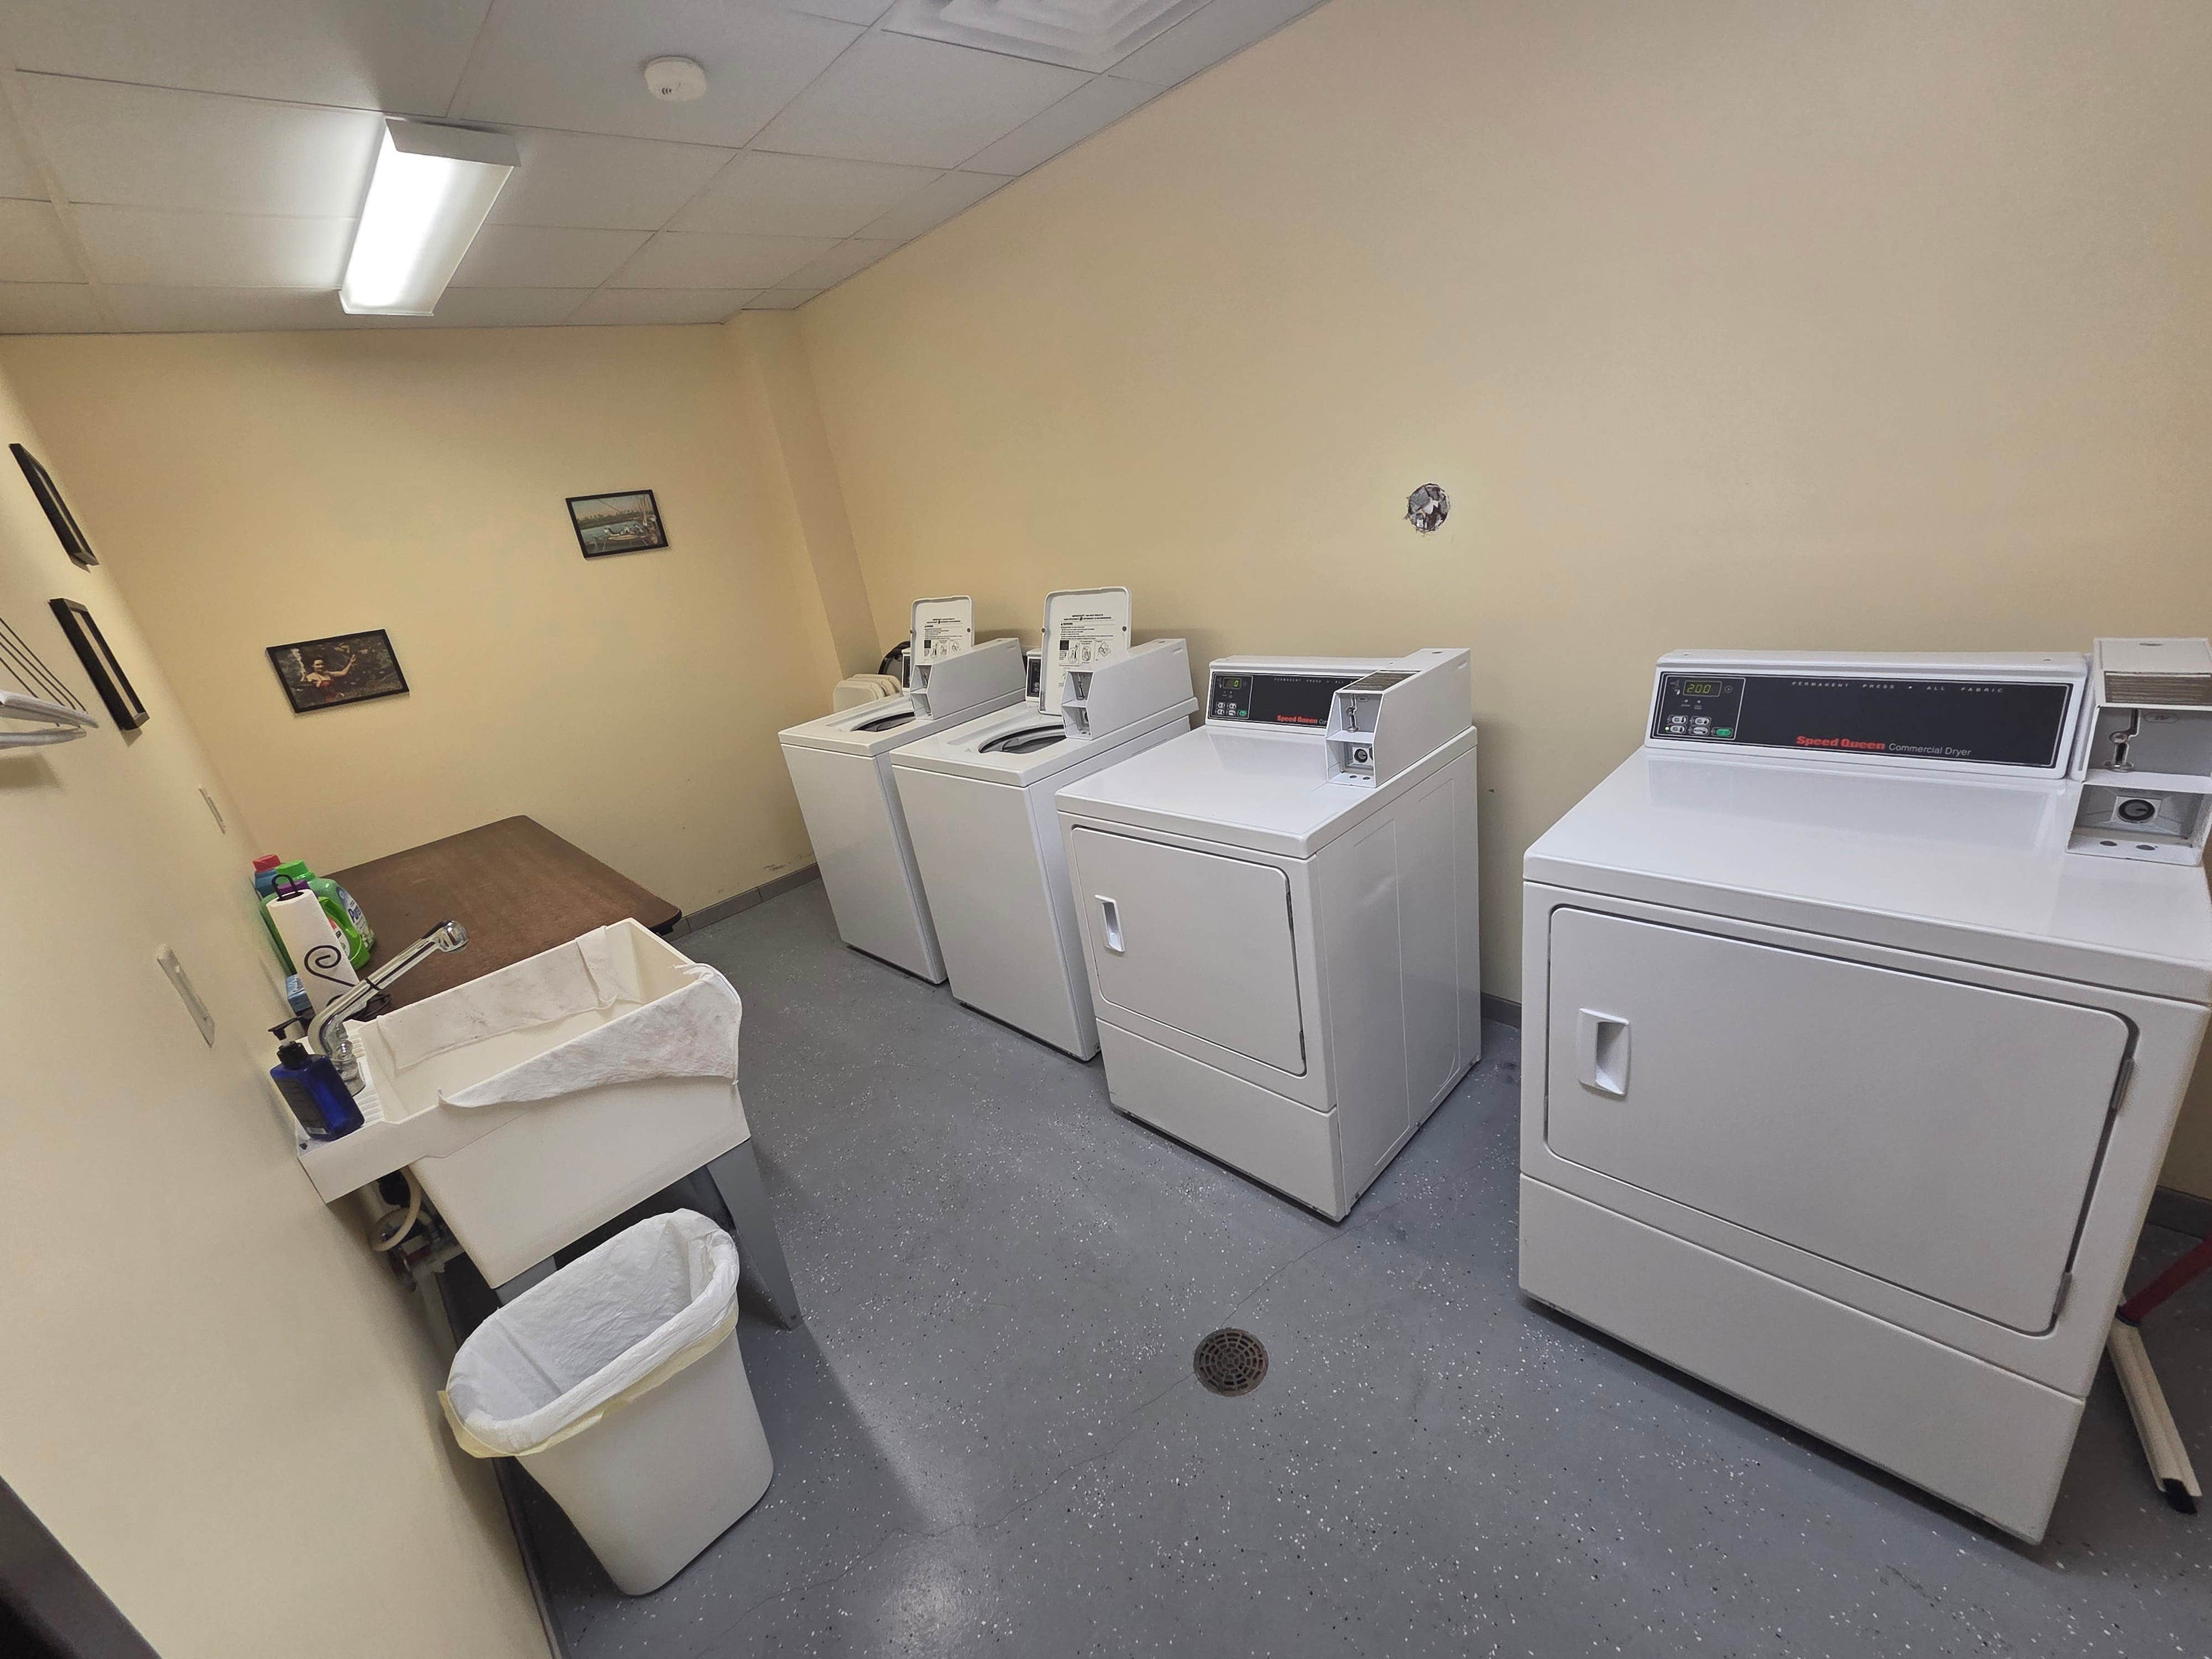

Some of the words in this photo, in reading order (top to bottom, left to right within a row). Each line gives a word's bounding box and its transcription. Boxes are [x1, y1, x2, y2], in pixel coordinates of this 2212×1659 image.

[1687, 684, 1712, 693] 200
[1277, 714, 1297, 722] Speed
[1796, 735, 1840, 747] Speed
[1840, 738, 1886, 750] Queen
[1888, 743, 1943, 754] Commercial
[1944, 747, 1972, 758] Dryer
